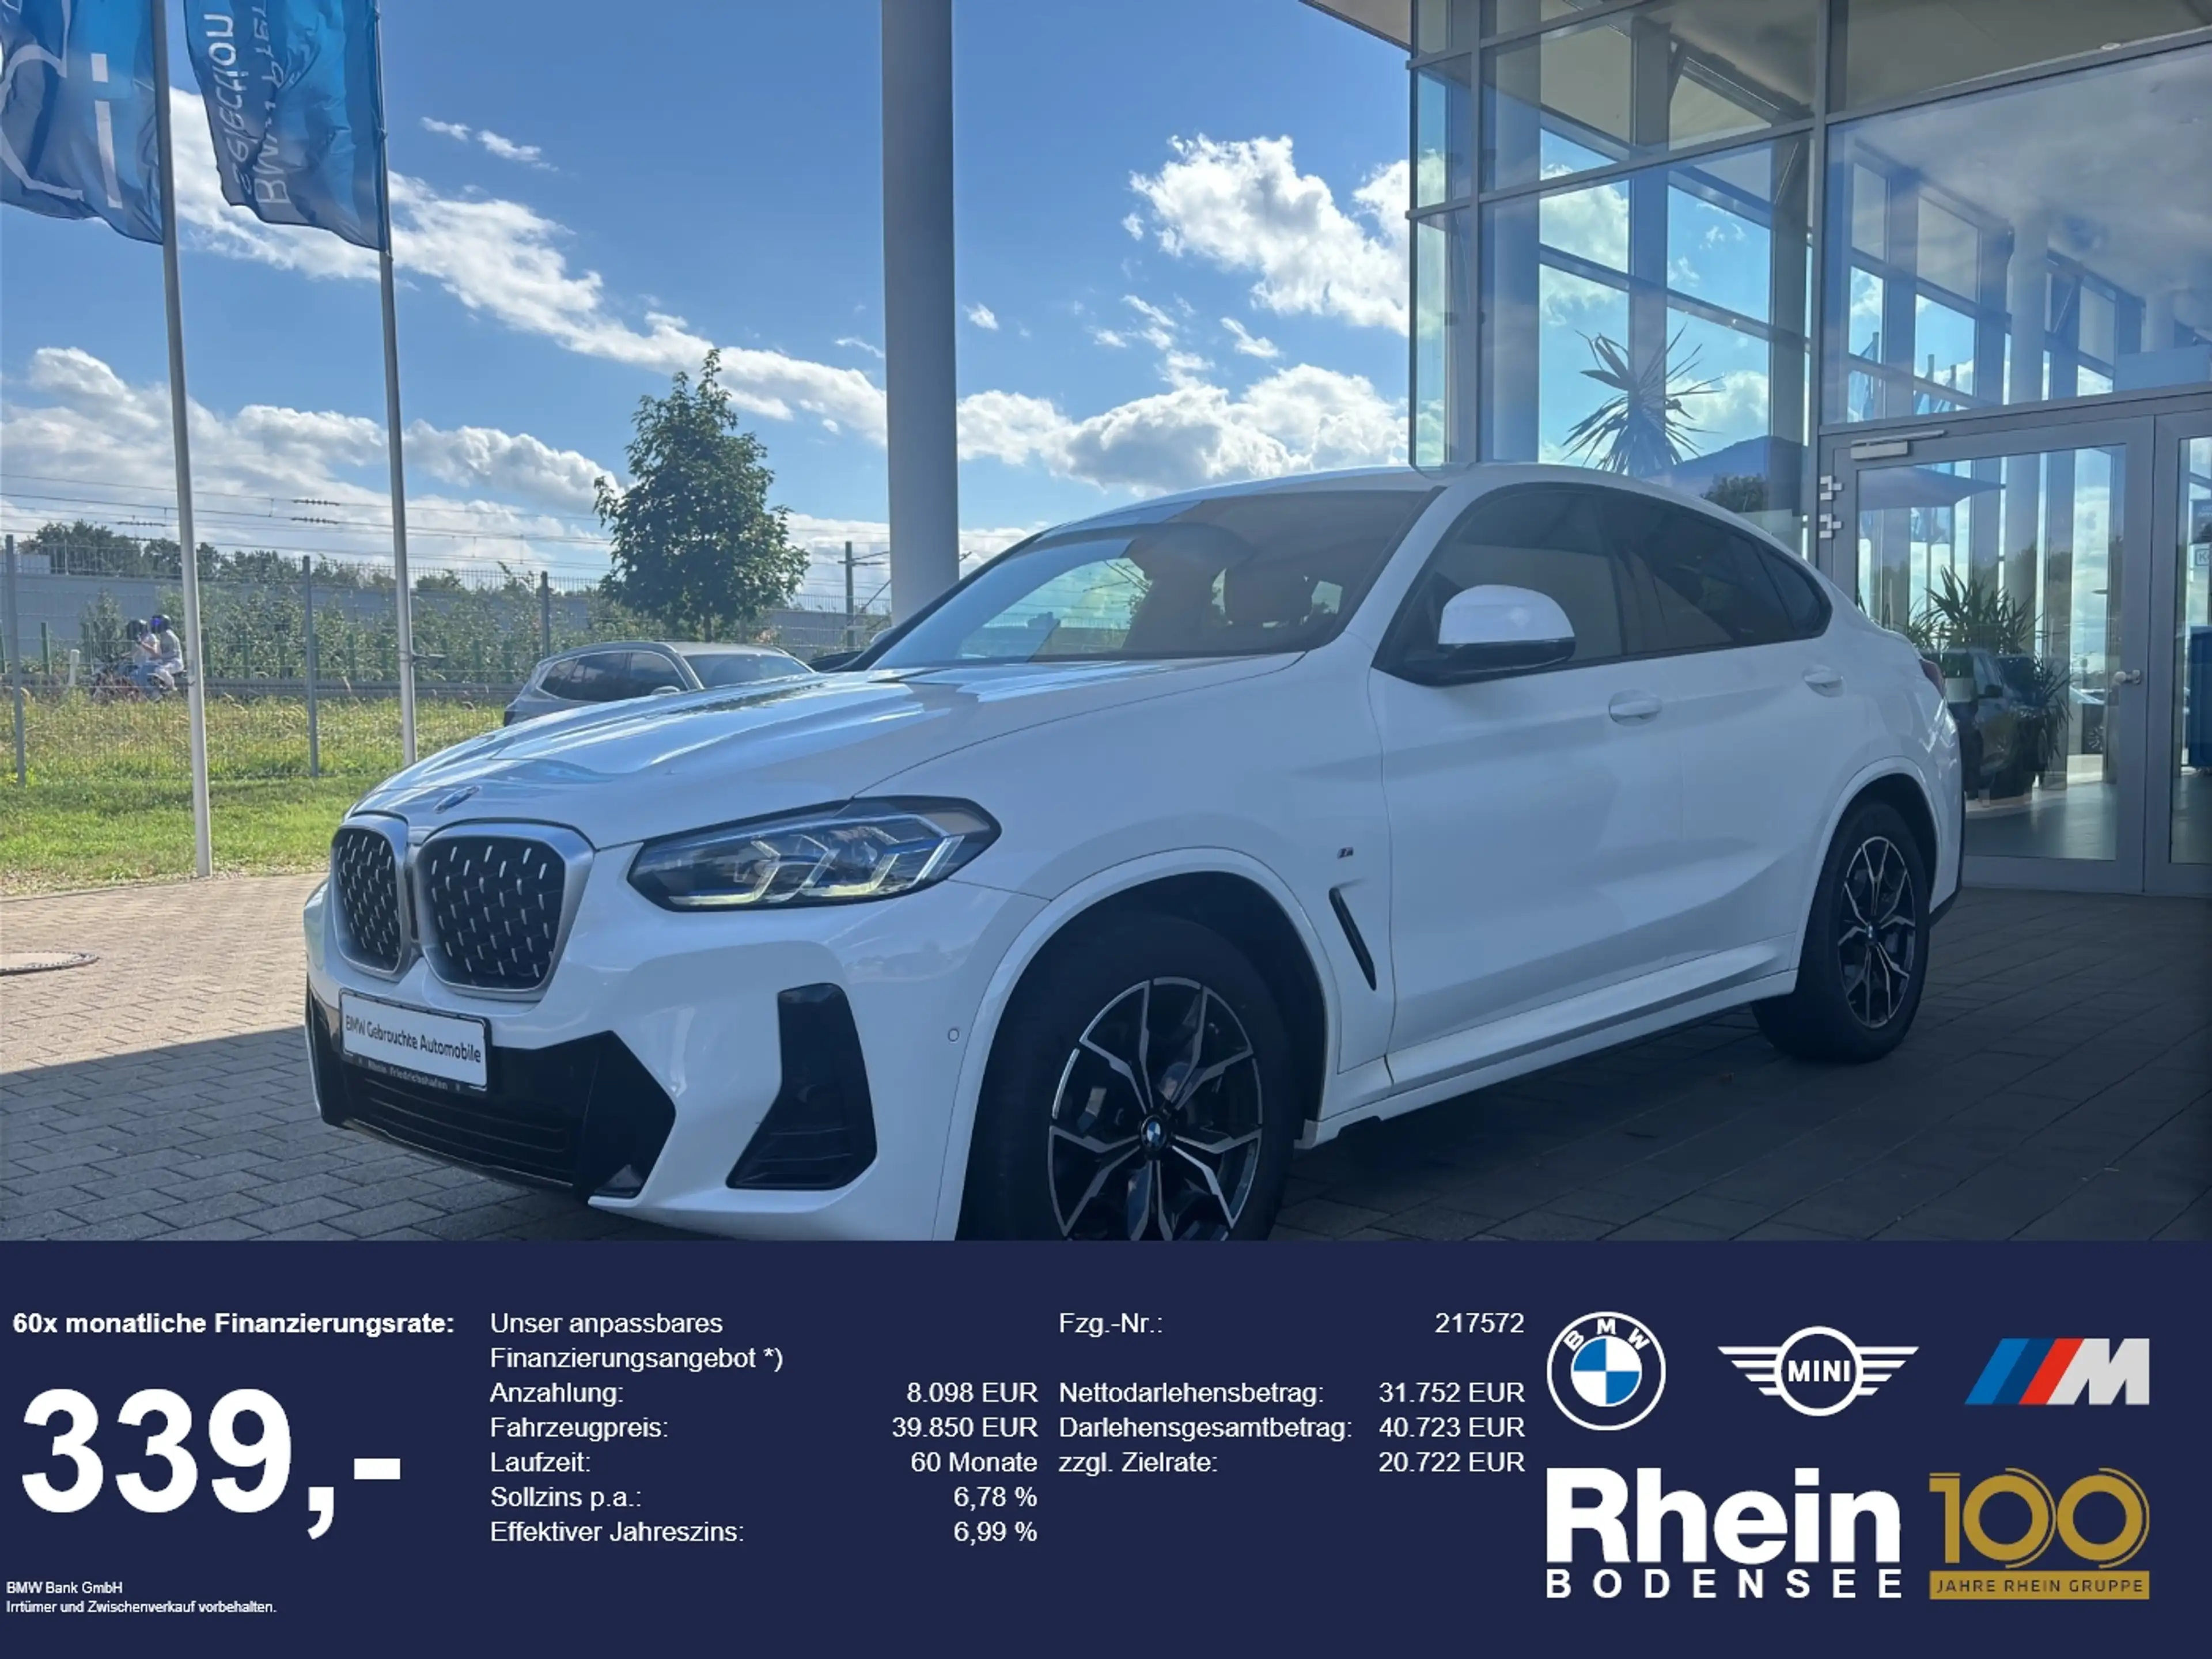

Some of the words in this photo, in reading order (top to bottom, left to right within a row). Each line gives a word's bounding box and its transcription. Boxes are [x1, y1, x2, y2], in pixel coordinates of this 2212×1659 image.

[346, 1014, 365, 1035] BMW
[366, 1021, 418, 1049] Gebrauchte
[420, 1034, 482, 1063] Automobile
